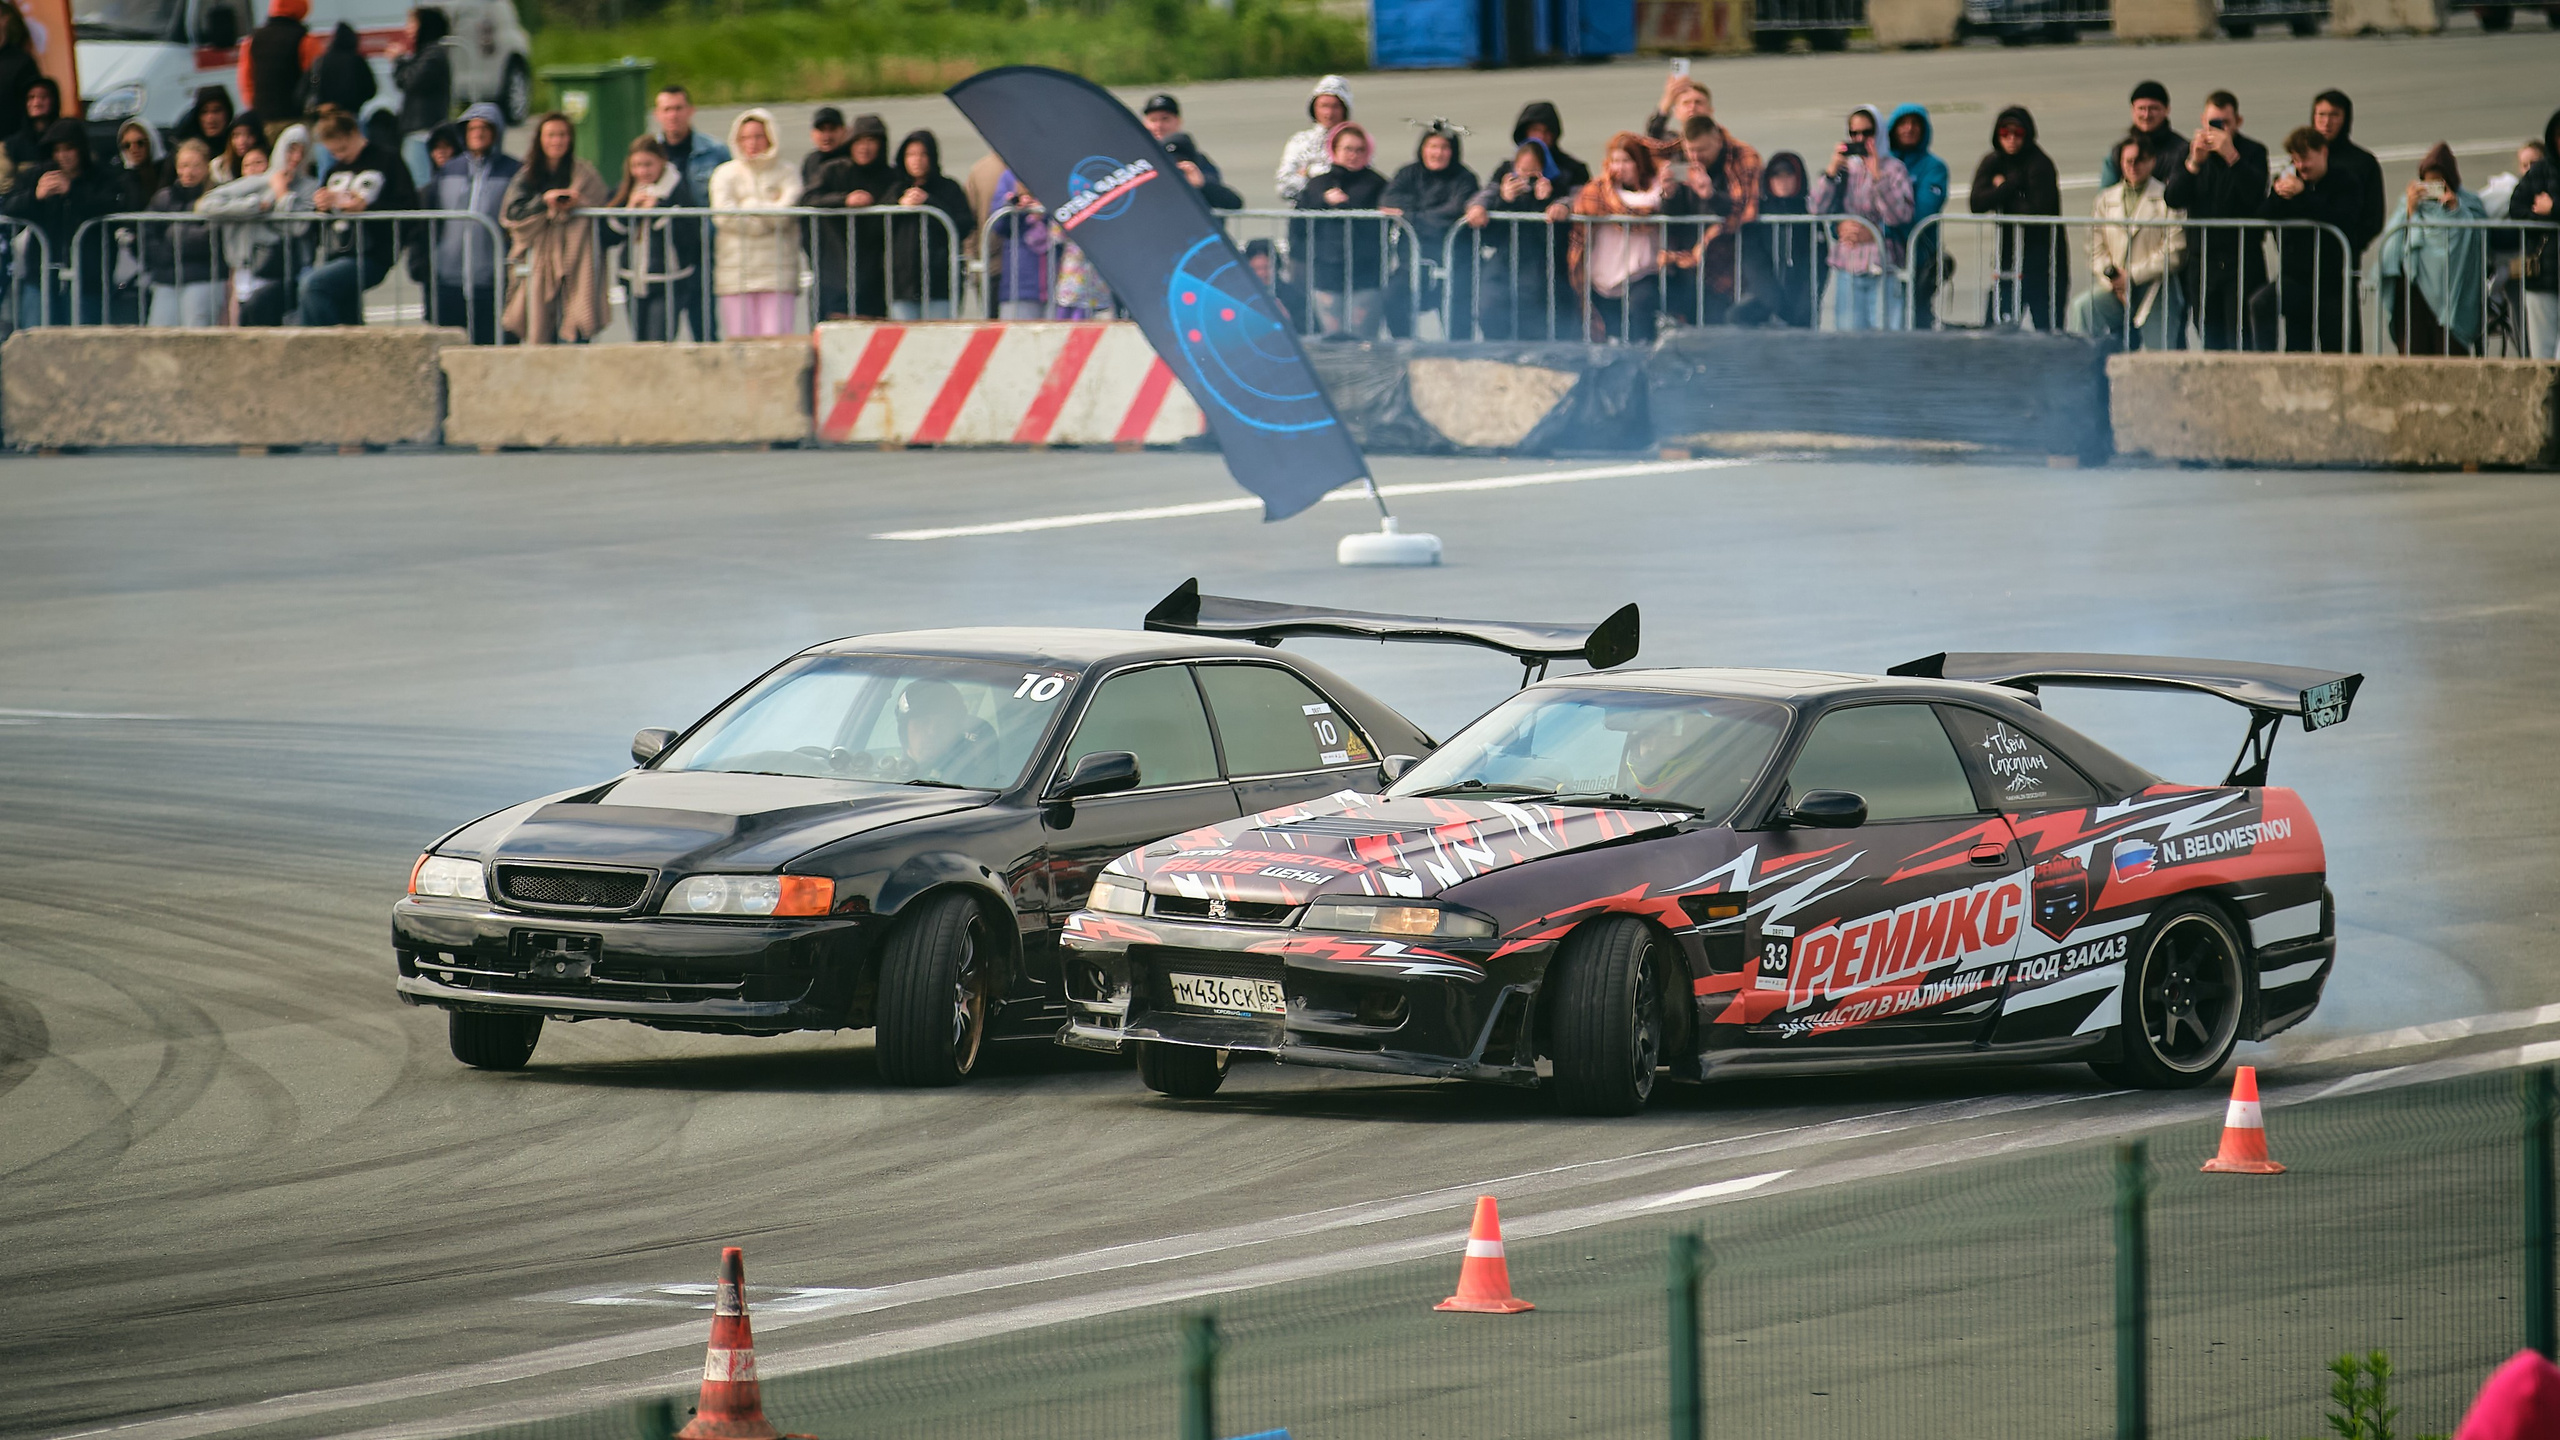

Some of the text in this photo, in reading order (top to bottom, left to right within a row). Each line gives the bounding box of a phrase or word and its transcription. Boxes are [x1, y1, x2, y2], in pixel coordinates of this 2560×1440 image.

[1013, 672, 1066, 702] 10
[1313, 719, 1338, 746] 10
[1990, 722, 2028, 754] Твой
[1989, 753, 2049, 777] Сахалин
[2162, 817, 2292, 863] N. BELOMESTNOV
[1154, 859, 1335, 885] ВЫШЕ ЦЕНЫ
[1223, 850, 1368, 874] КАЧЕСТВО
[1763, 943, 1788, 971] 33
[1789, 881, 2023, 1008] РЕМИКС
[1259, 984, 1280, 1003] 65
[1779, 936, 2128, 1039] ЗАПЧАСТИ В НАЛИЧИИ И ПОД ЗАКАЗ
